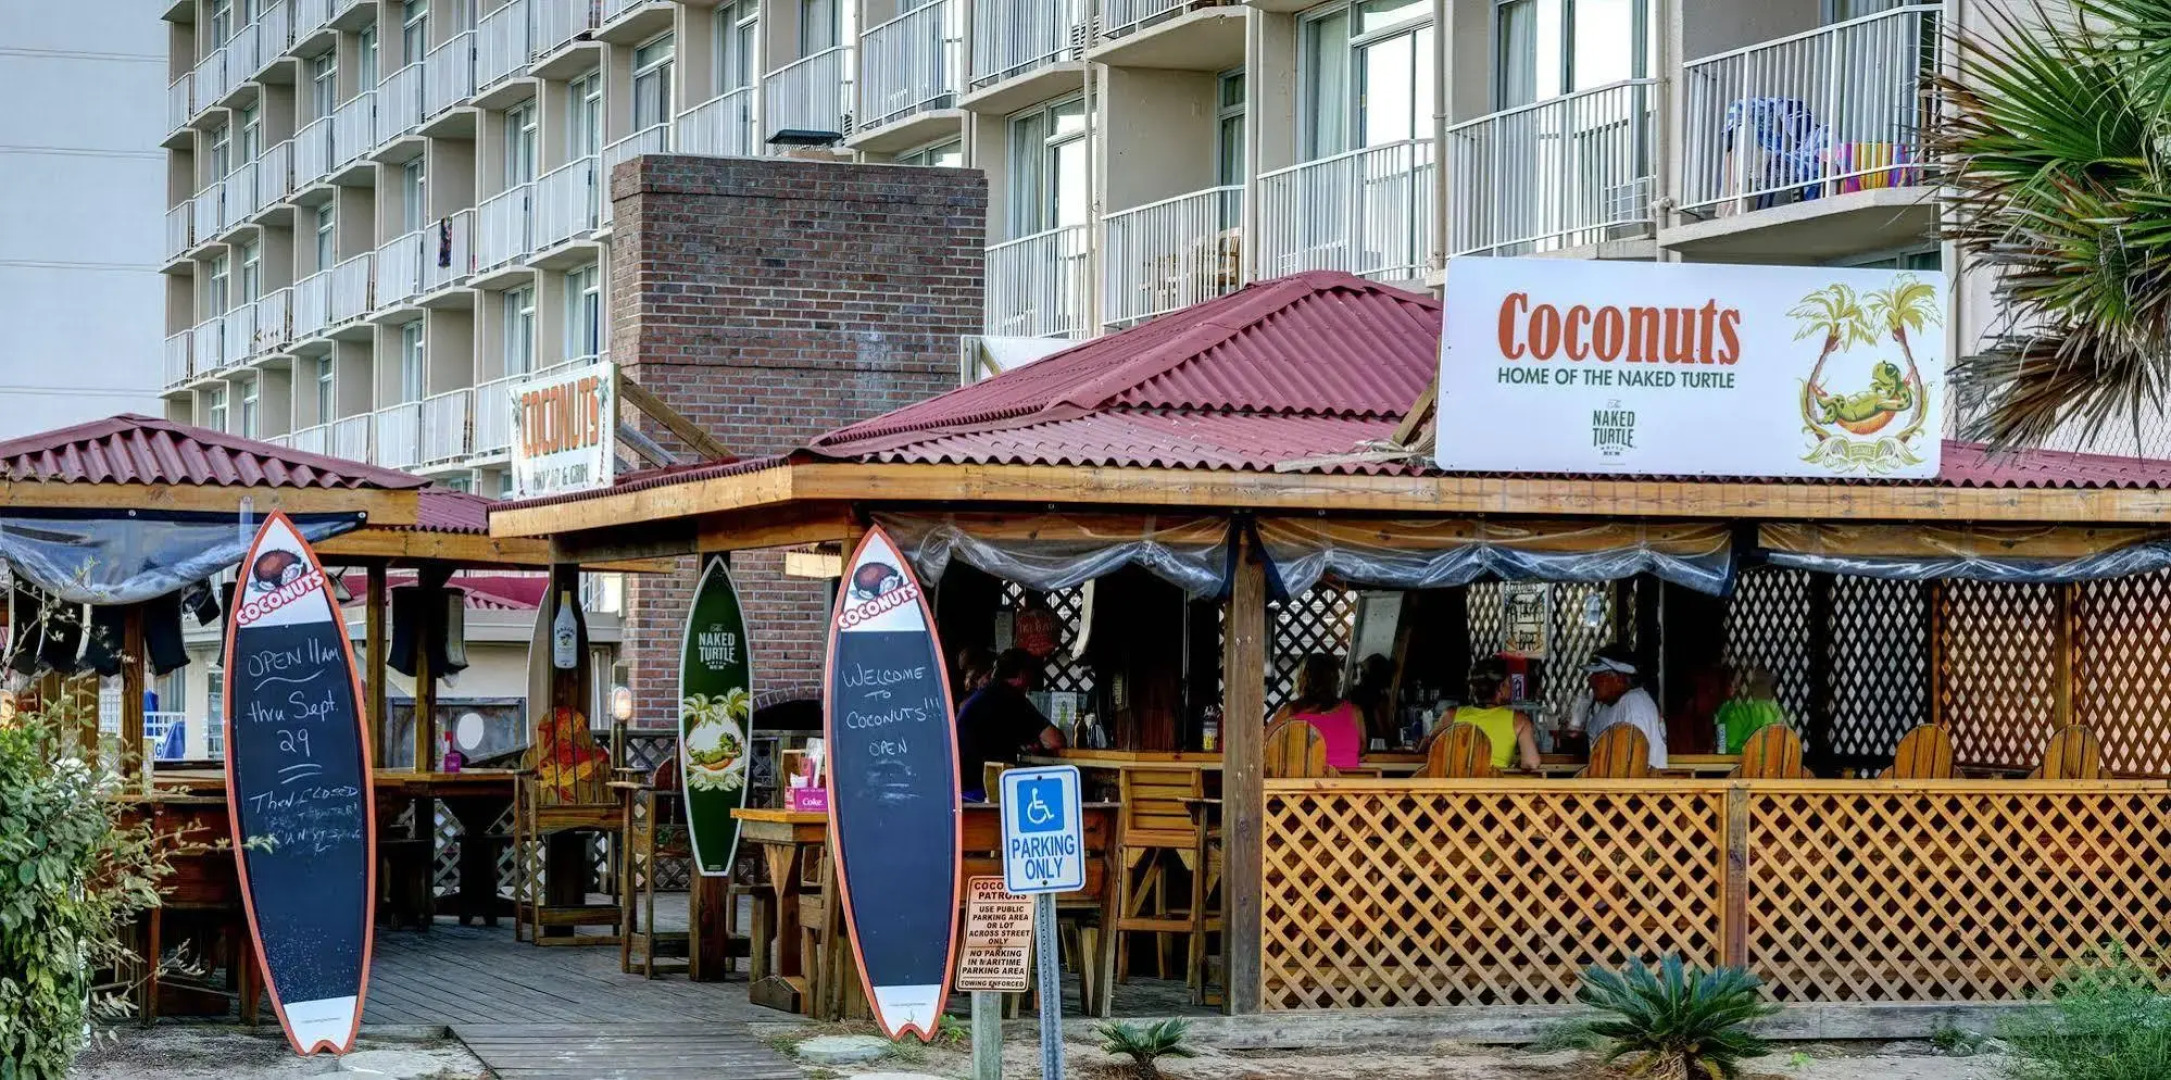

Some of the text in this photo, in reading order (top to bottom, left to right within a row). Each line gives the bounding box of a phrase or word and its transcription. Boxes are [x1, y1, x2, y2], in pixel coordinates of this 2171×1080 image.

[1498, 292, 1740, 365] Coconuts
[1498, 367, 1735, 389] HOME OF THE NAKED TURTLE
[521, 375, 599, 459] COCONUTS
[1593, 410, 1635, 427] NAKED
[1593, 428, 1636, 448] TURTLE
[235, 568, 326, 626] COCONUTS
[837, 582, 918, 629] COCONUTS
[698, 632, 736, 646] NAKED
[248, 646, 302, 677] OPEN
[698, 646, 736, 663] TURTLE
[842, 663, 926, 688] WELCOME
[864, 690, 892, 701] TO
[247, 690, 338, 723] thru Sept.
[277, 729, 310, 757] 29
[868, 738, 907, 757] OPEN
[802, 797, 824, 806] Coke
[1011, 834, 1075, 859] PARKING
[1025, 857, 1063, 880] ONLY
[974, 881, 1004, 890] COCO
[978, 891, 1027, 900] PATRONS
[979, 905, 1024, 913] USE PUBLIC
[962, 967, 1025, 975] PARKING AREA
